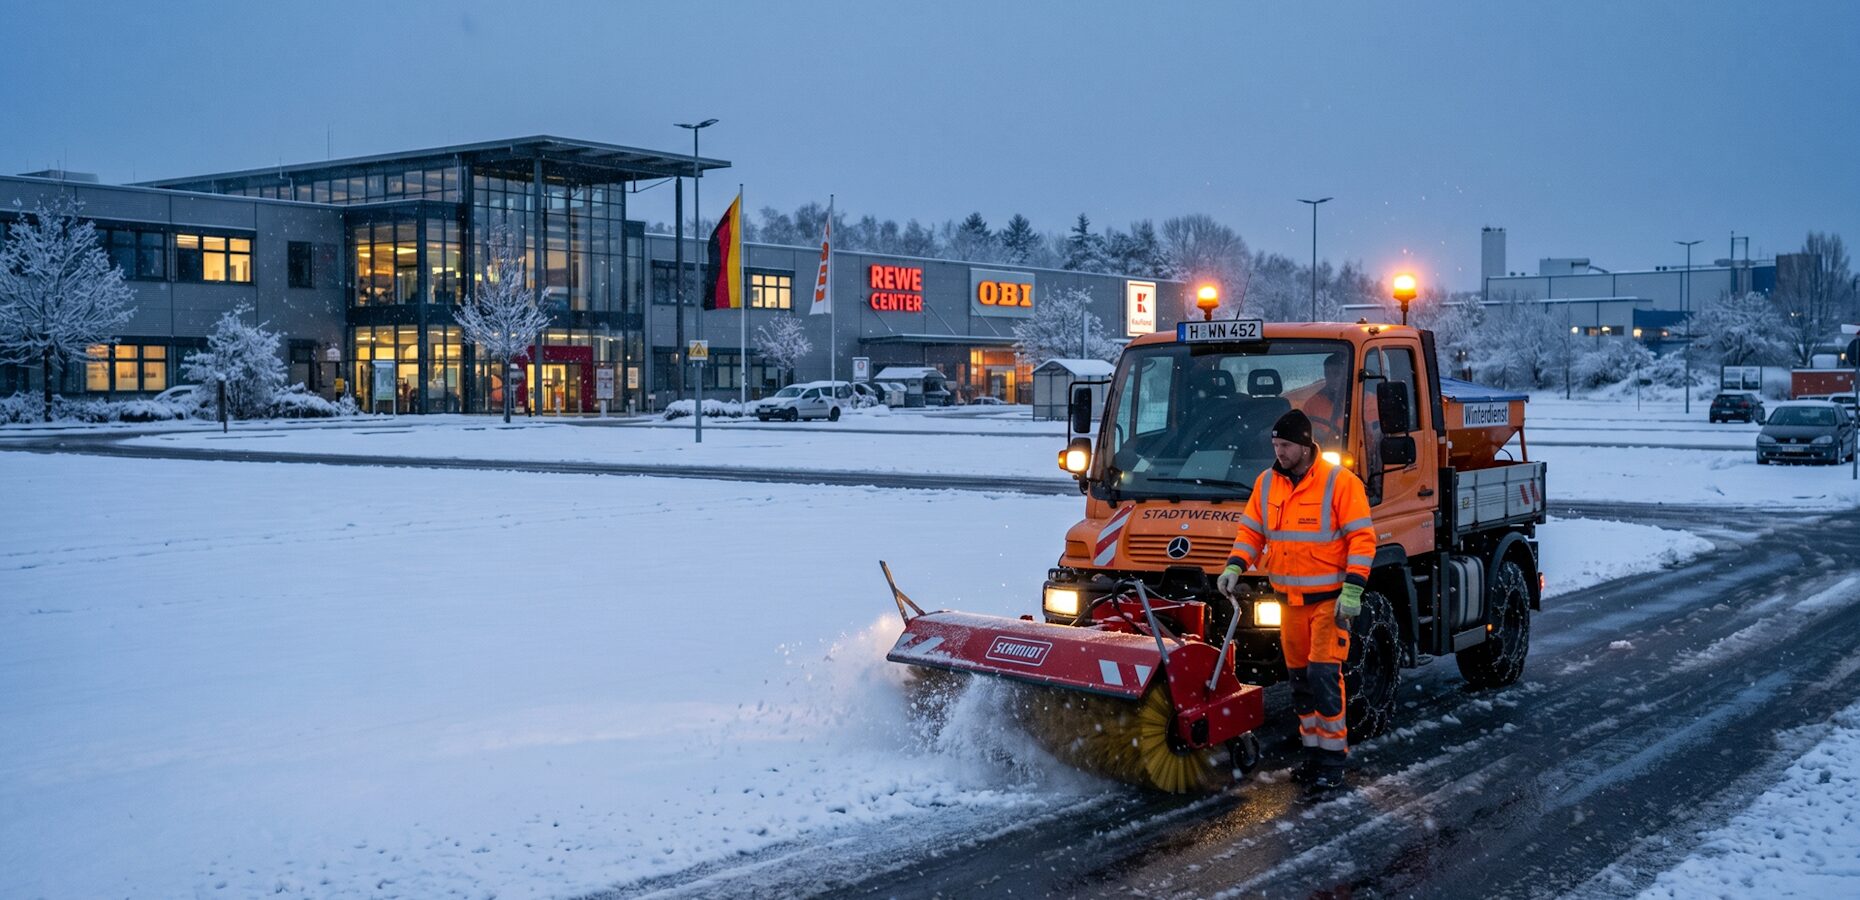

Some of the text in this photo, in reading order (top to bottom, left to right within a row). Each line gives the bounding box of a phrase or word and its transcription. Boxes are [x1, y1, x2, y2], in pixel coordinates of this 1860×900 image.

[870, 264, 922, 291] REWE
[870, 292, 922, 312] CENTER
[979, 280, 1032, 307] OBI
[1190, 322, 1256, 339] H WN 452
[1465, 404, 1507, 425] Winterdienst
[1142, 509, 1242, 522] STADTWERKE
[993, 642, 1045, 659] SCHMIDT
